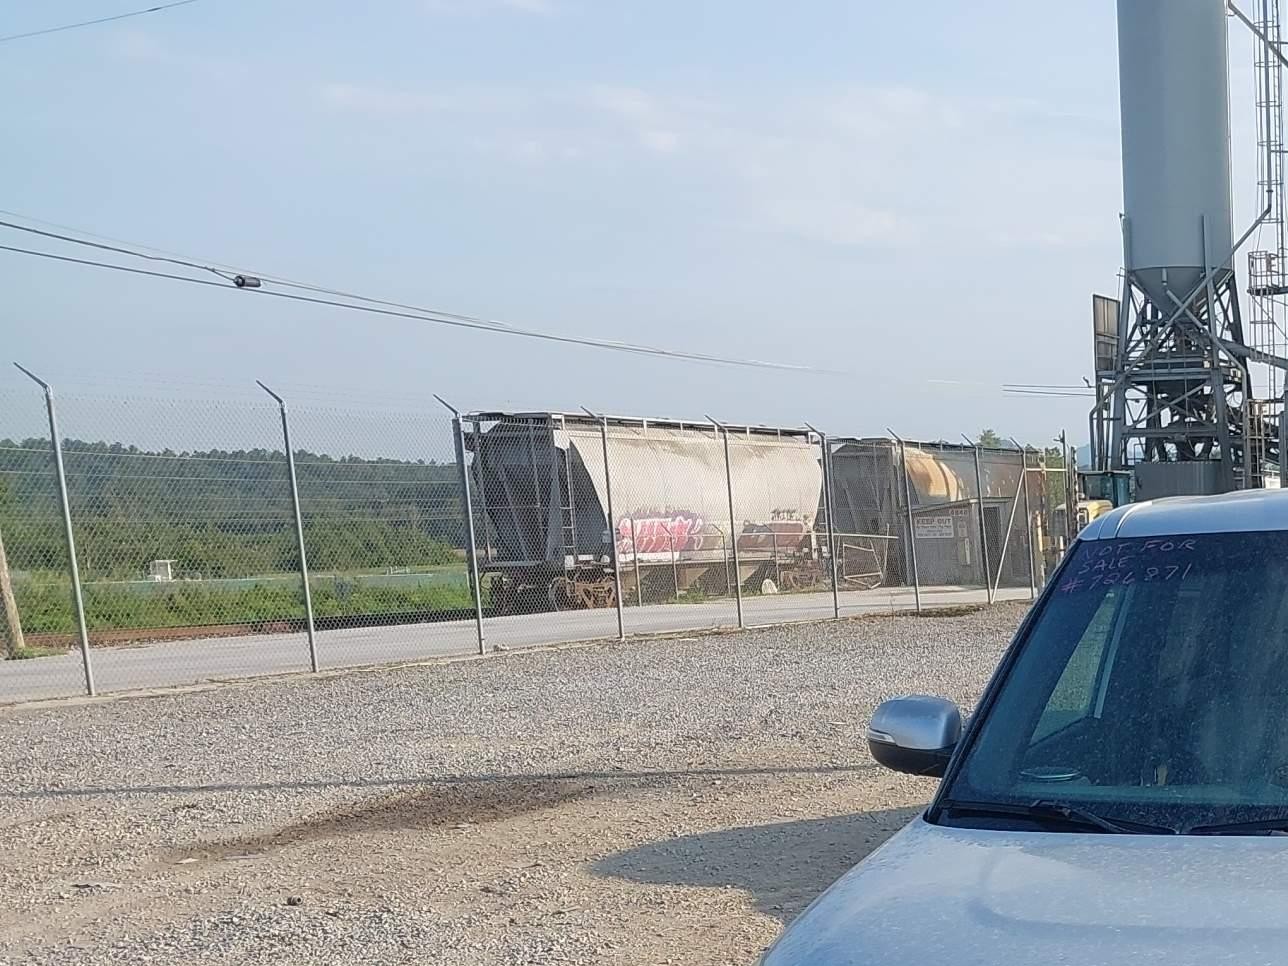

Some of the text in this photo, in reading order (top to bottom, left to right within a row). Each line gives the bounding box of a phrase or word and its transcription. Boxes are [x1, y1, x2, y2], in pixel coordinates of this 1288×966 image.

[1083, 539, 1196, 559] NOT FOR
[1079, 555, 1134, 574] SALE
